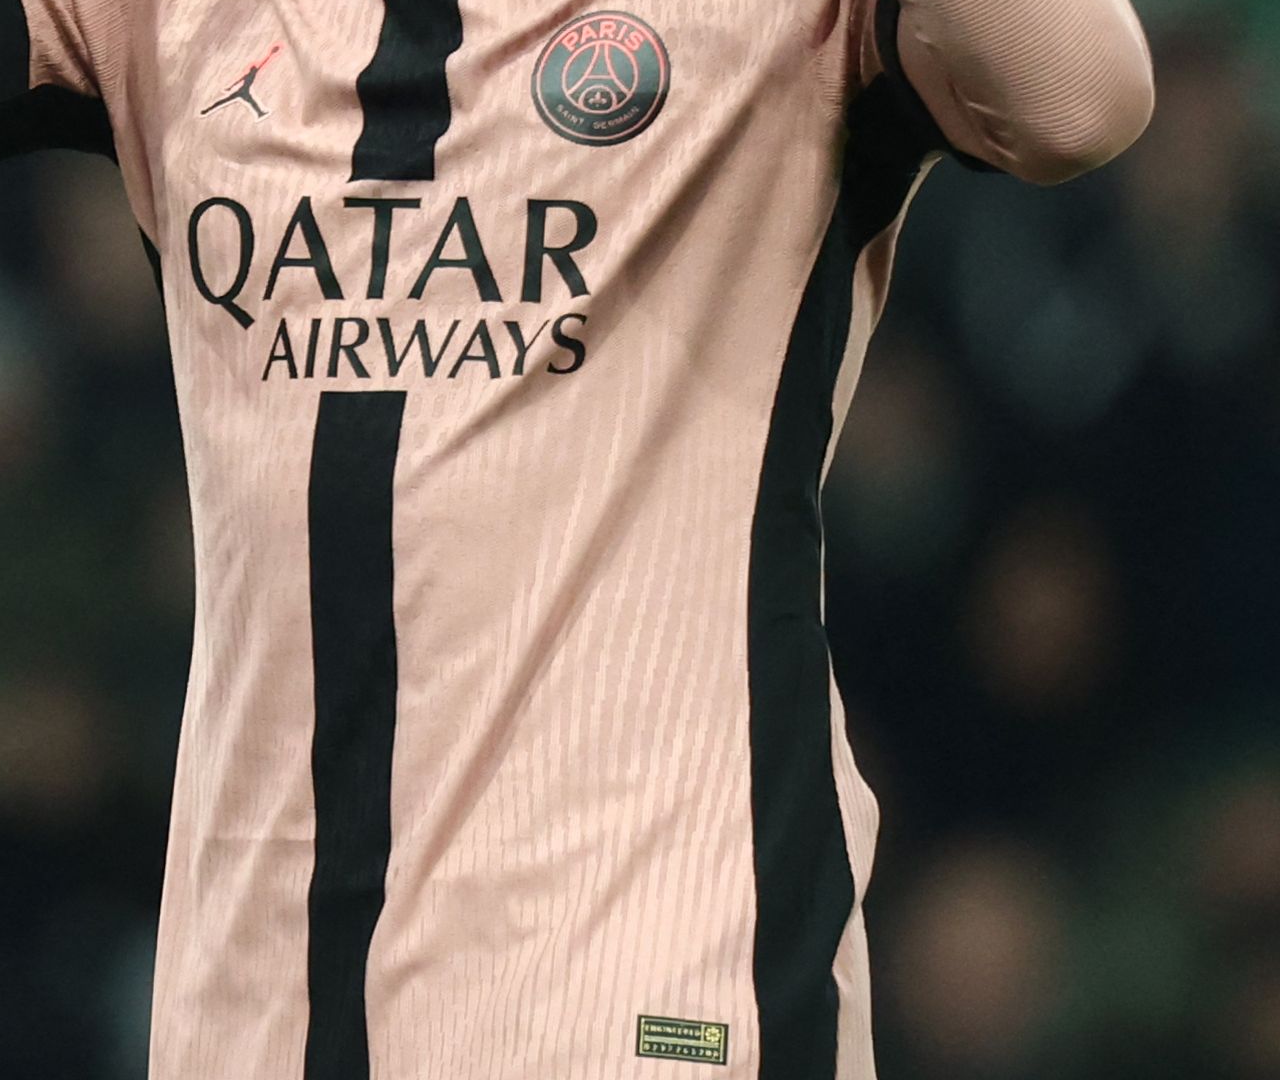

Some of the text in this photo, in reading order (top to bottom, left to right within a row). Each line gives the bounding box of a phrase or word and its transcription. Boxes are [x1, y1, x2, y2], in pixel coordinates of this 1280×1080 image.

[561, 20, 644, 51] PARIS
[187, 195, 598, 330] QATAR
[261, 312, 588, 381] AIRWAYS
